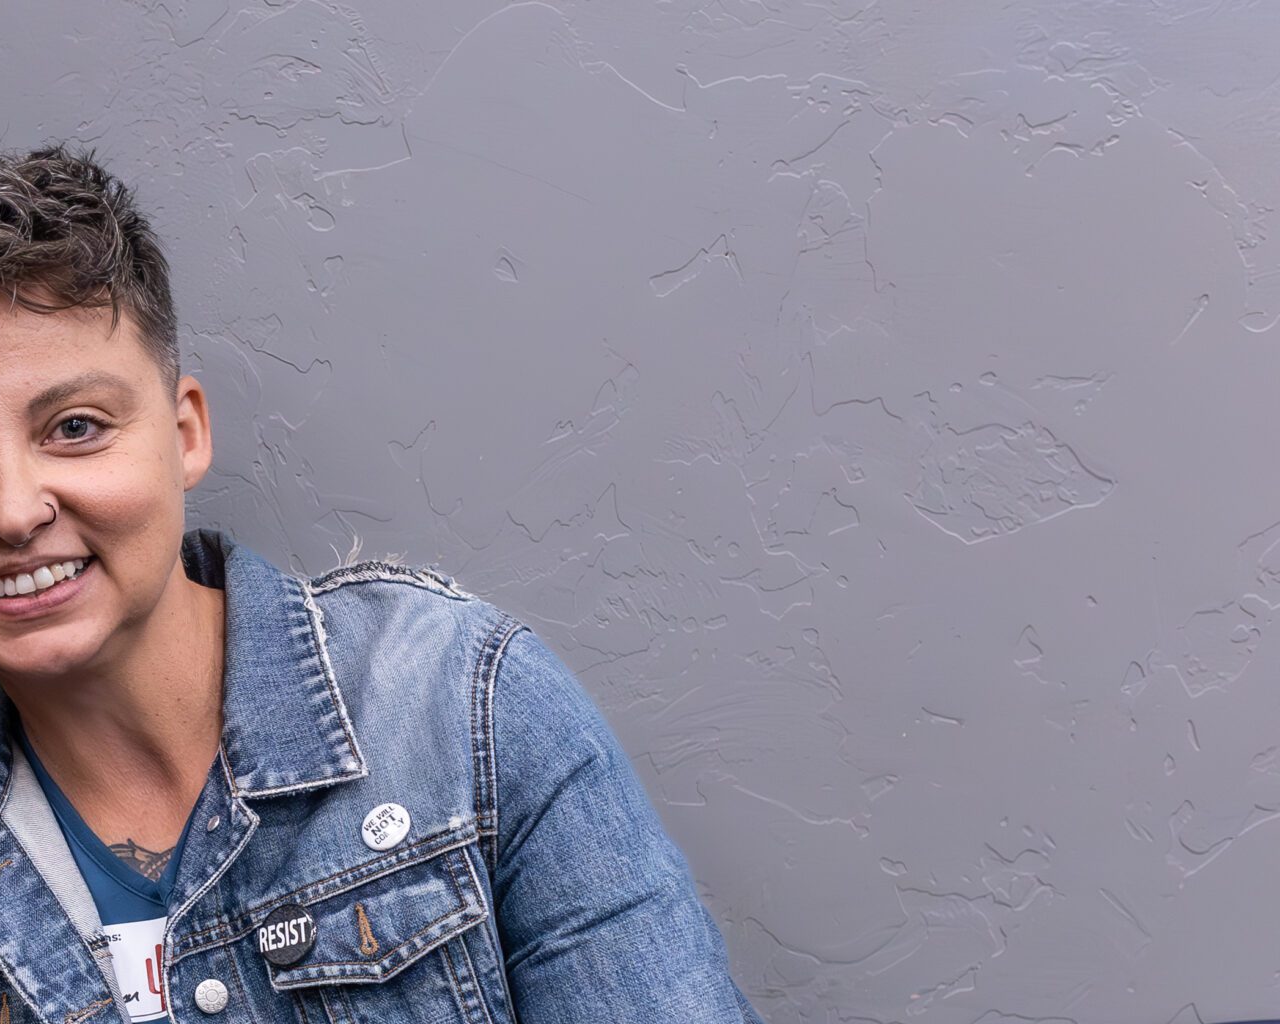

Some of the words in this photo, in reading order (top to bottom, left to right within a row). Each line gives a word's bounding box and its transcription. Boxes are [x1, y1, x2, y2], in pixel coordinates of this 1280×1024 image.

[363, 818, 377, 832] WE
[376, 805, 396, 820] WILL
[370, 813, 396, 837] NOT
[259, 916, 308, 953] RESIST
